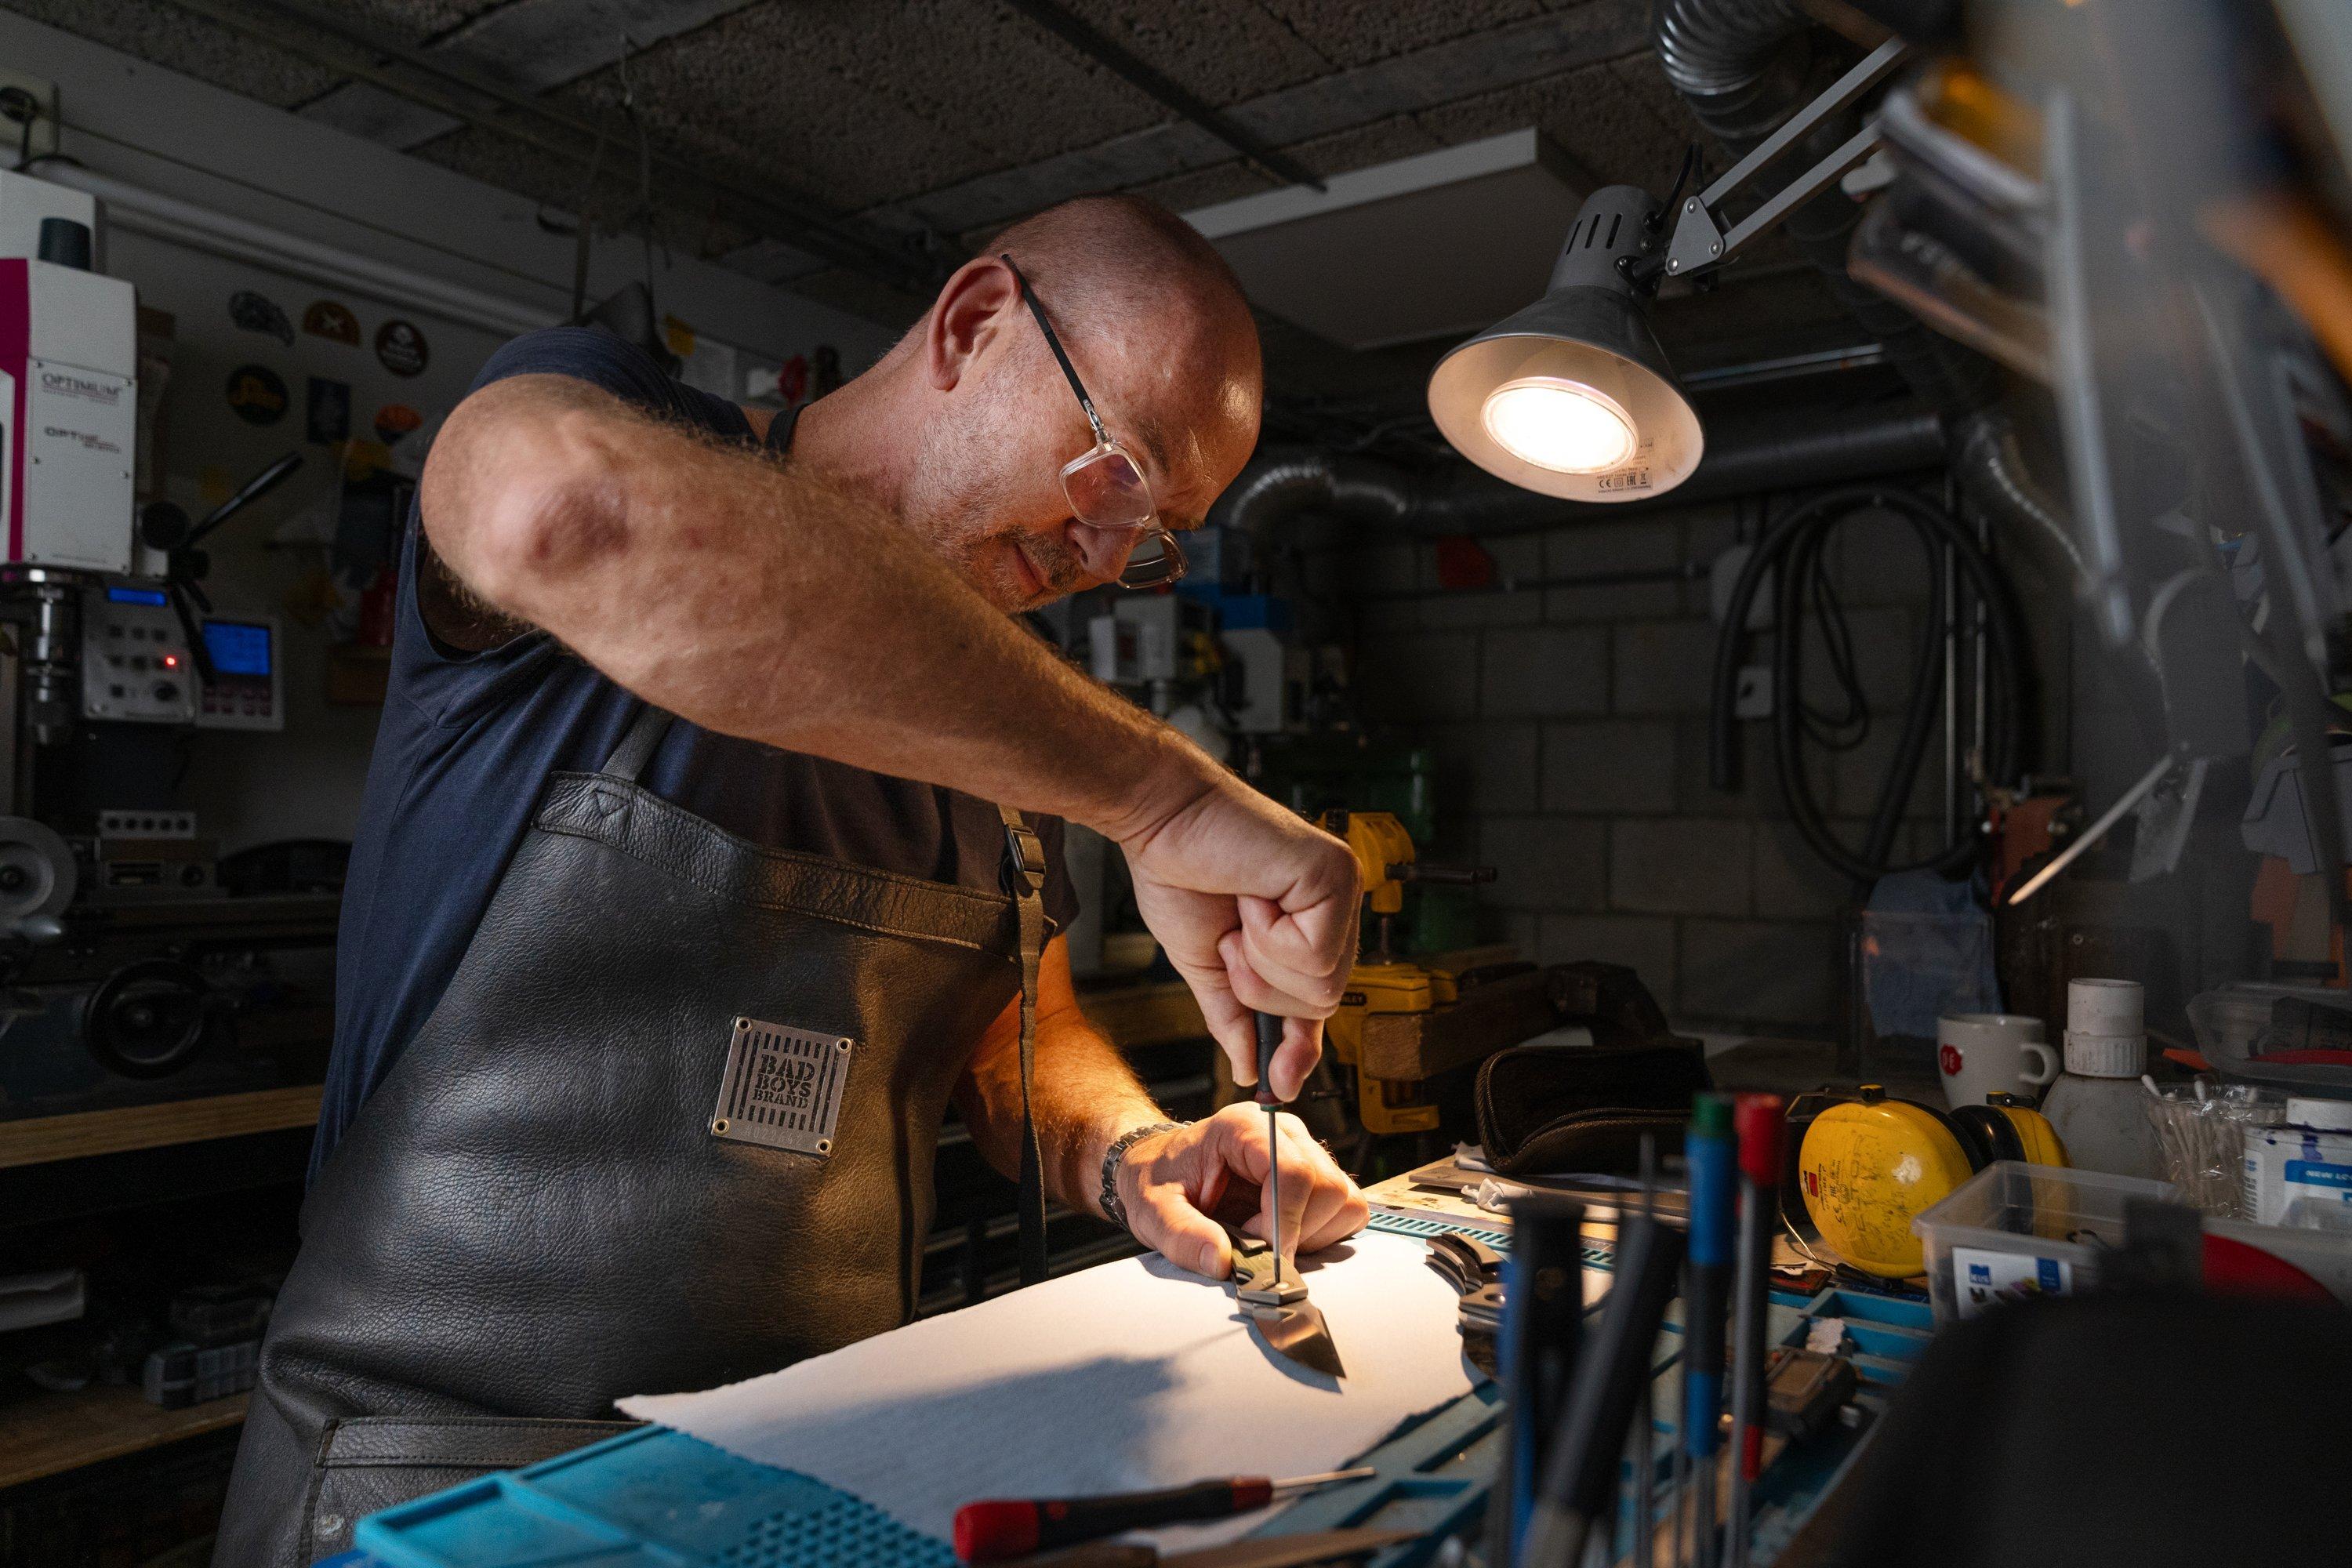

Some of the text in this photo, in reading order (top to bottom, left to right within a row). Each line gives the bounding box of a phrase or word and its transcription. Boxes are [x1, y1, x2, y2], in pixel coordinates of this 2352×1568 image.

[758, 1054, 815, 1082] BAD
[755, 1073, 812, 1098] BOYS
[753, 1088, 809, 1109] BRAND
